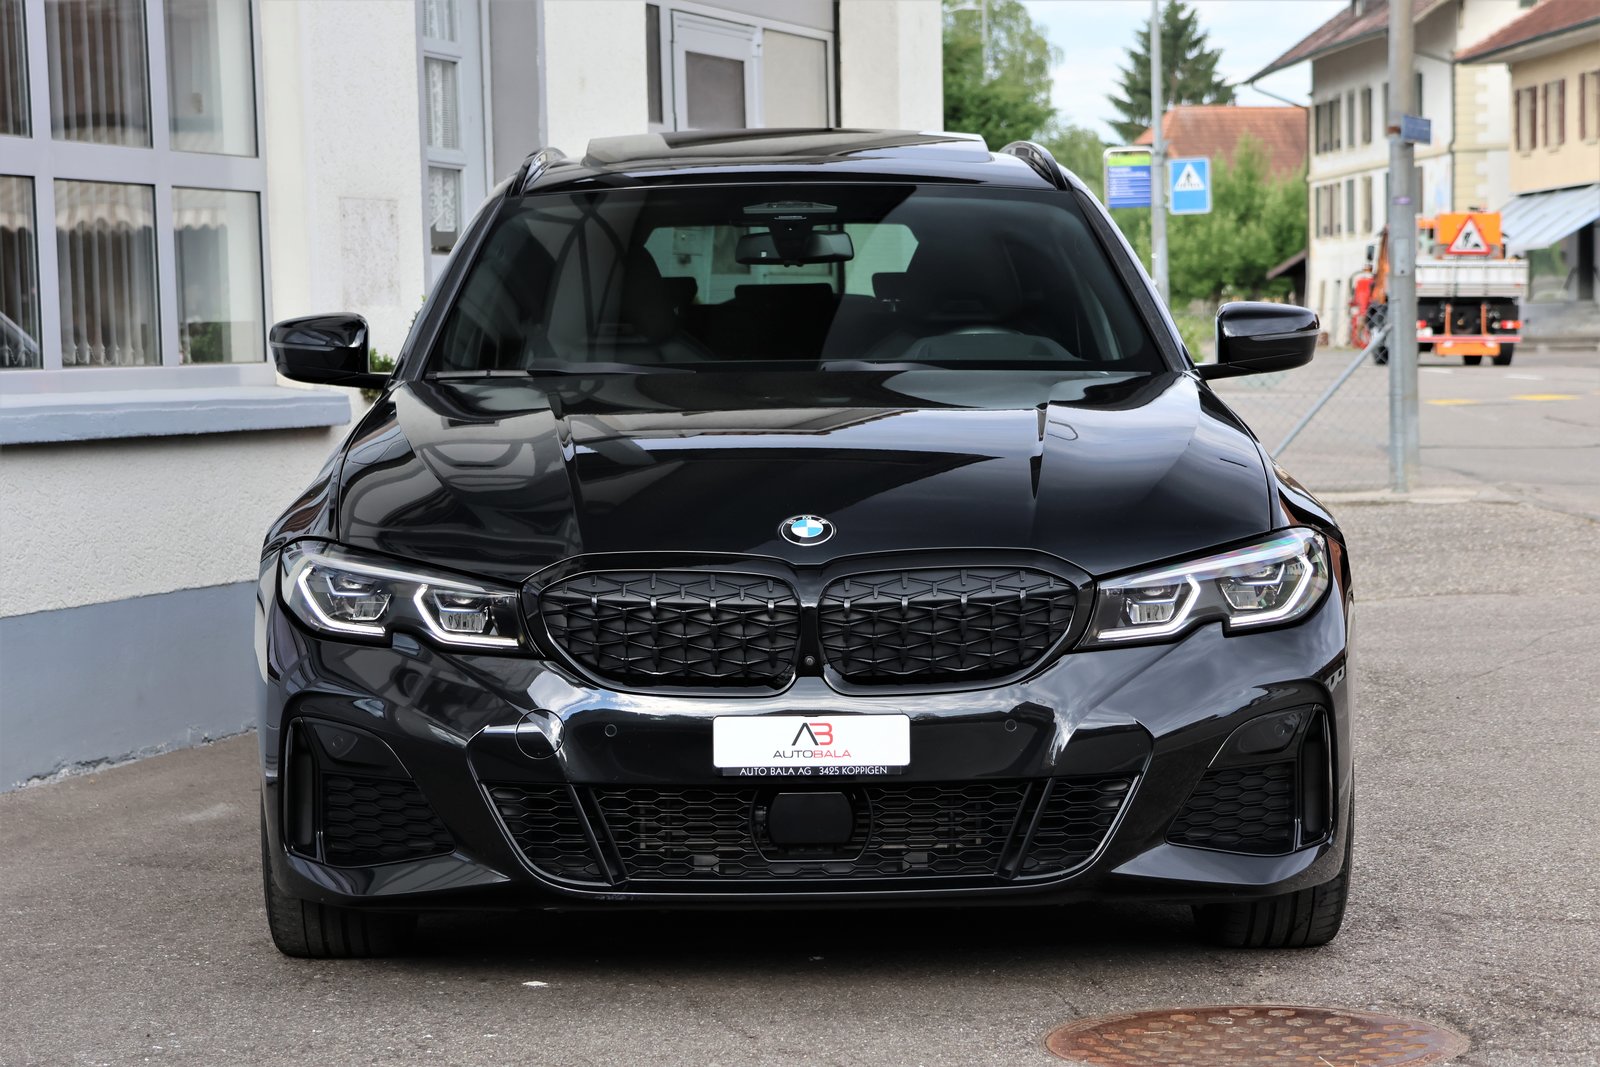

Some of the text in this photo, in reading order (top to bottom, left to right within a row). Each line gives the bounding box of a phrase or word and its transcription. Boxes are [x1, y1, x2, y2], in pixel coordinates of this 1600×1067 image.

[773, 749, 852, 758] AUTOBALA
[739, 765, 888, 776] AUTO BALA AG 3425 KOPPIGEN
